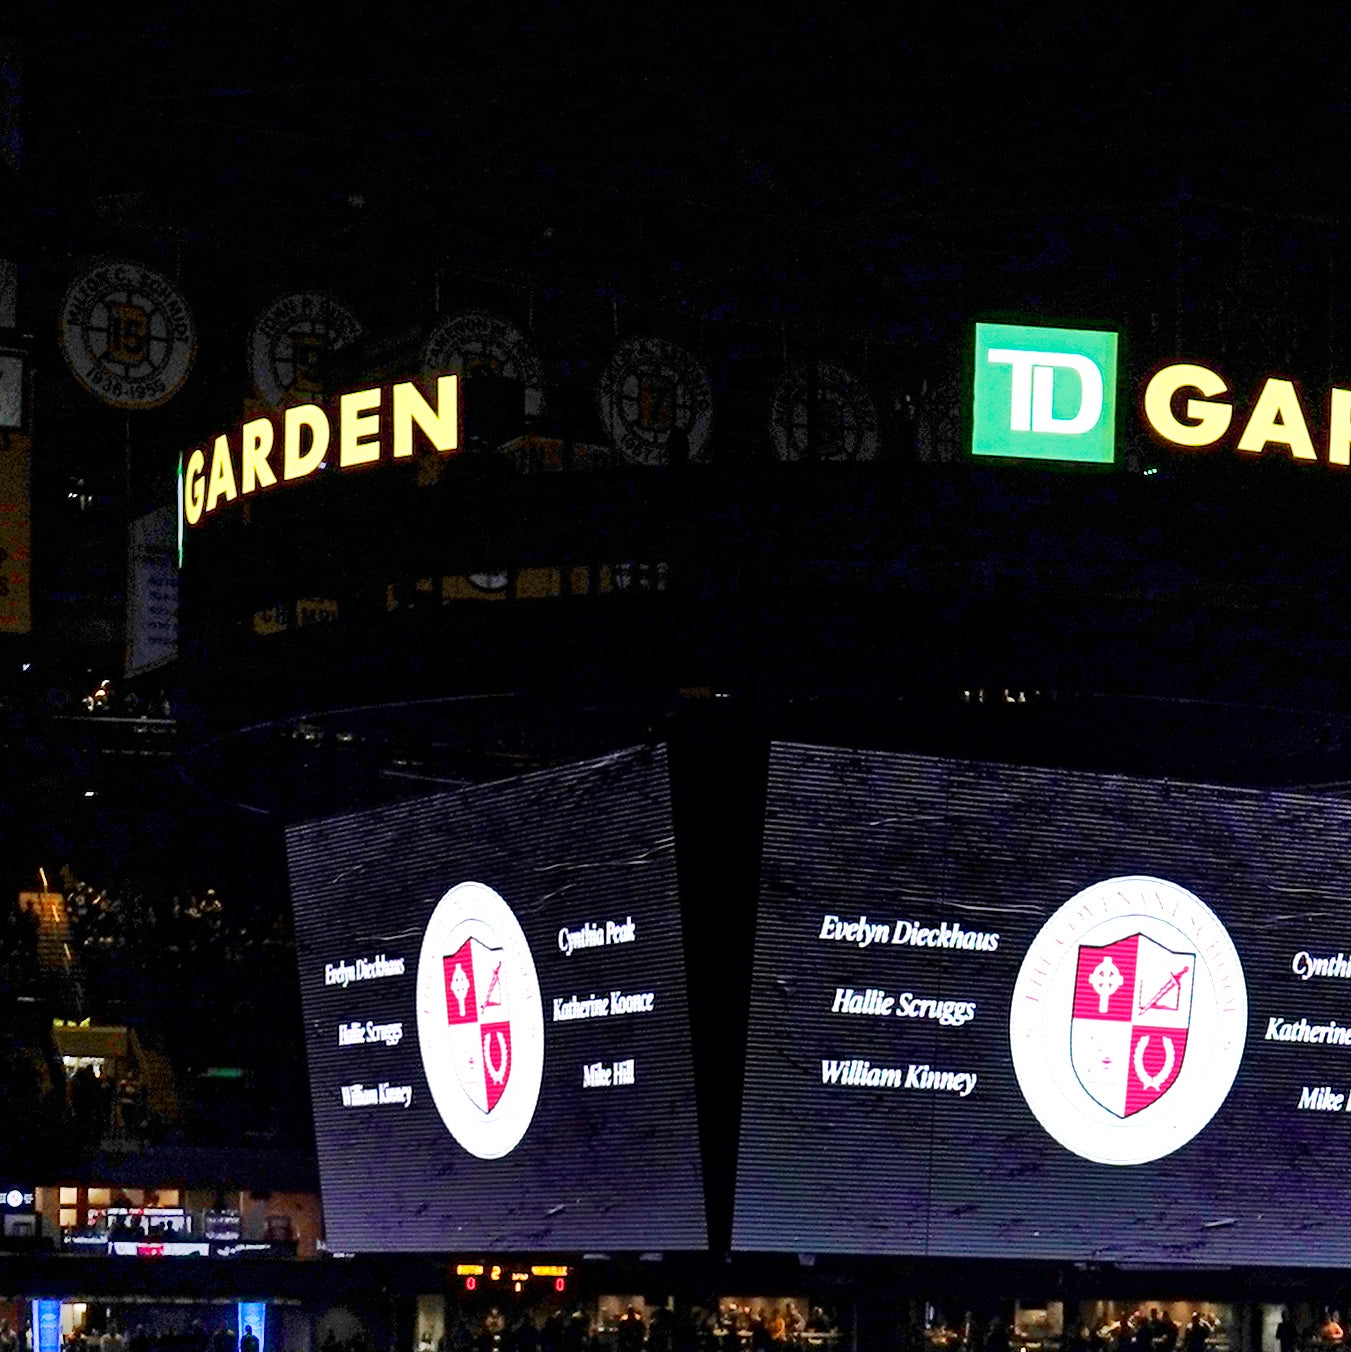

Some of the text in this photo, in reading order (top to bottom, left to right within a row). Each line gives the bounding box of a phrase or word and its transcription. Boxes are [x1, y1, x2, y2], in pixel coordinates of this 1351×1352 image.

[986, 348, 1104, 436] TD
[183, 374, 460, 526] GARDEN
[558, 916, 636, 956] Cynthia Peak
[819, 914, 1000, 952] Evelyn Dieckhaus
[553, 991, 654, 1021] Katherine Koonce
[831, 987, 977, 1026] Hallie Scruggs
[583, 1059, 635, 1088] Mike Hill
[821, 1059, 978, 1097] William Kinney
[1297, 1086, 1345, 1112] Mike
